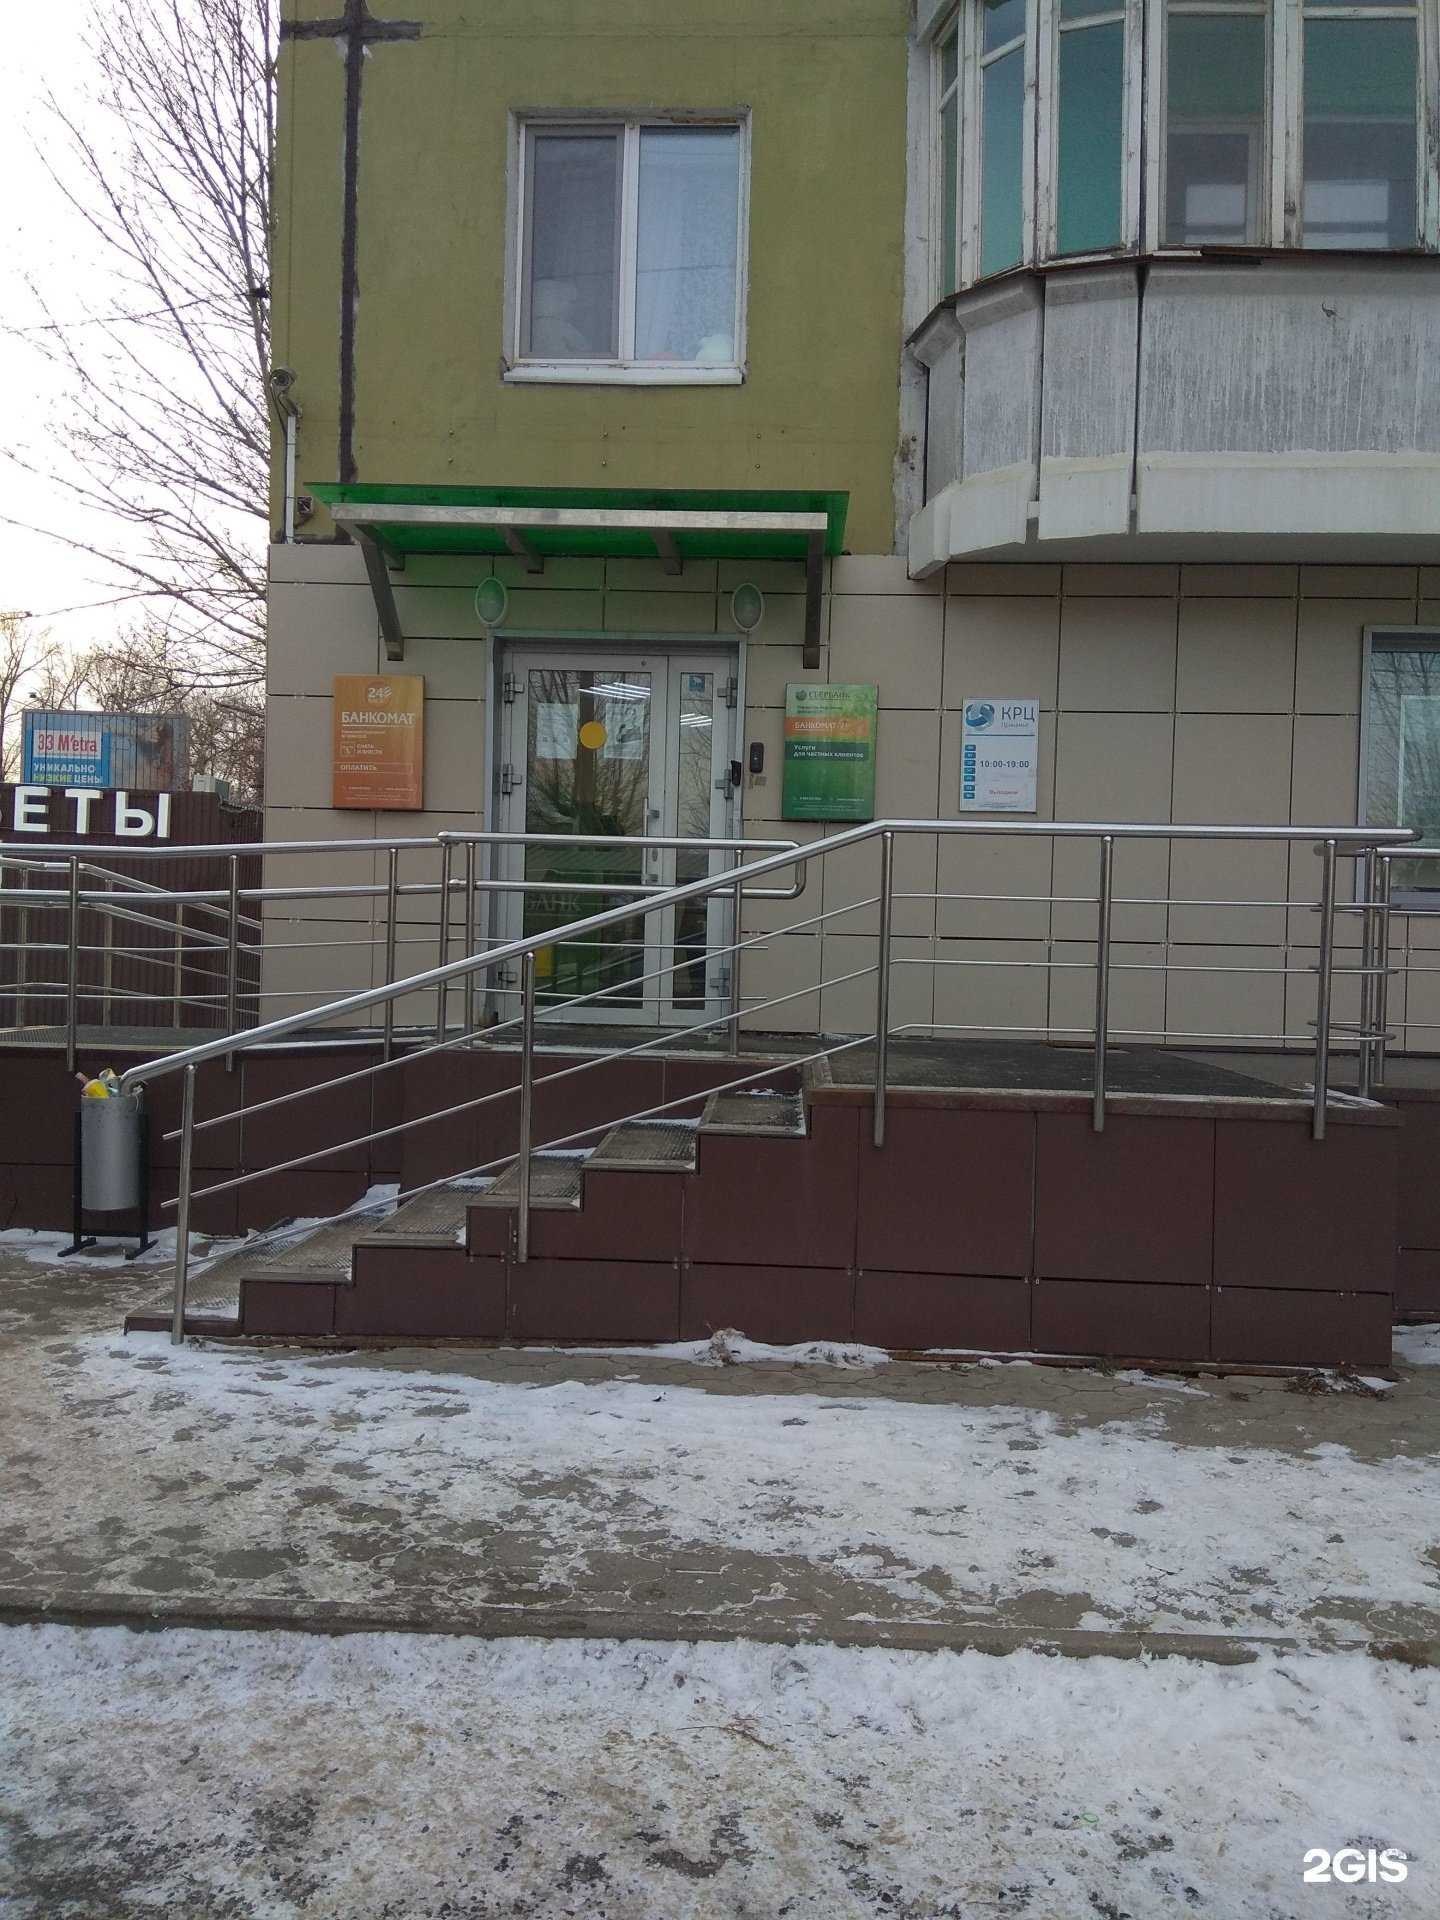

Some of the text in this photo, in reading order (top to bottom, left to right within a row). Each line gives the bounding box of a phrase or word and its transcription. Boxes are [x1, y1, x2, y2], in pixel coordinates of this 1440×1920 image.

[341, 711, 416, 725] БАНКОМАТ
[1001, 706, 1035, 723] КРЦ
[38, 733, 54, 751] 33
[33, 762, 96, 774] УНИКАЛЬНО
[0, 785, 171, 839] ЕТЫ
